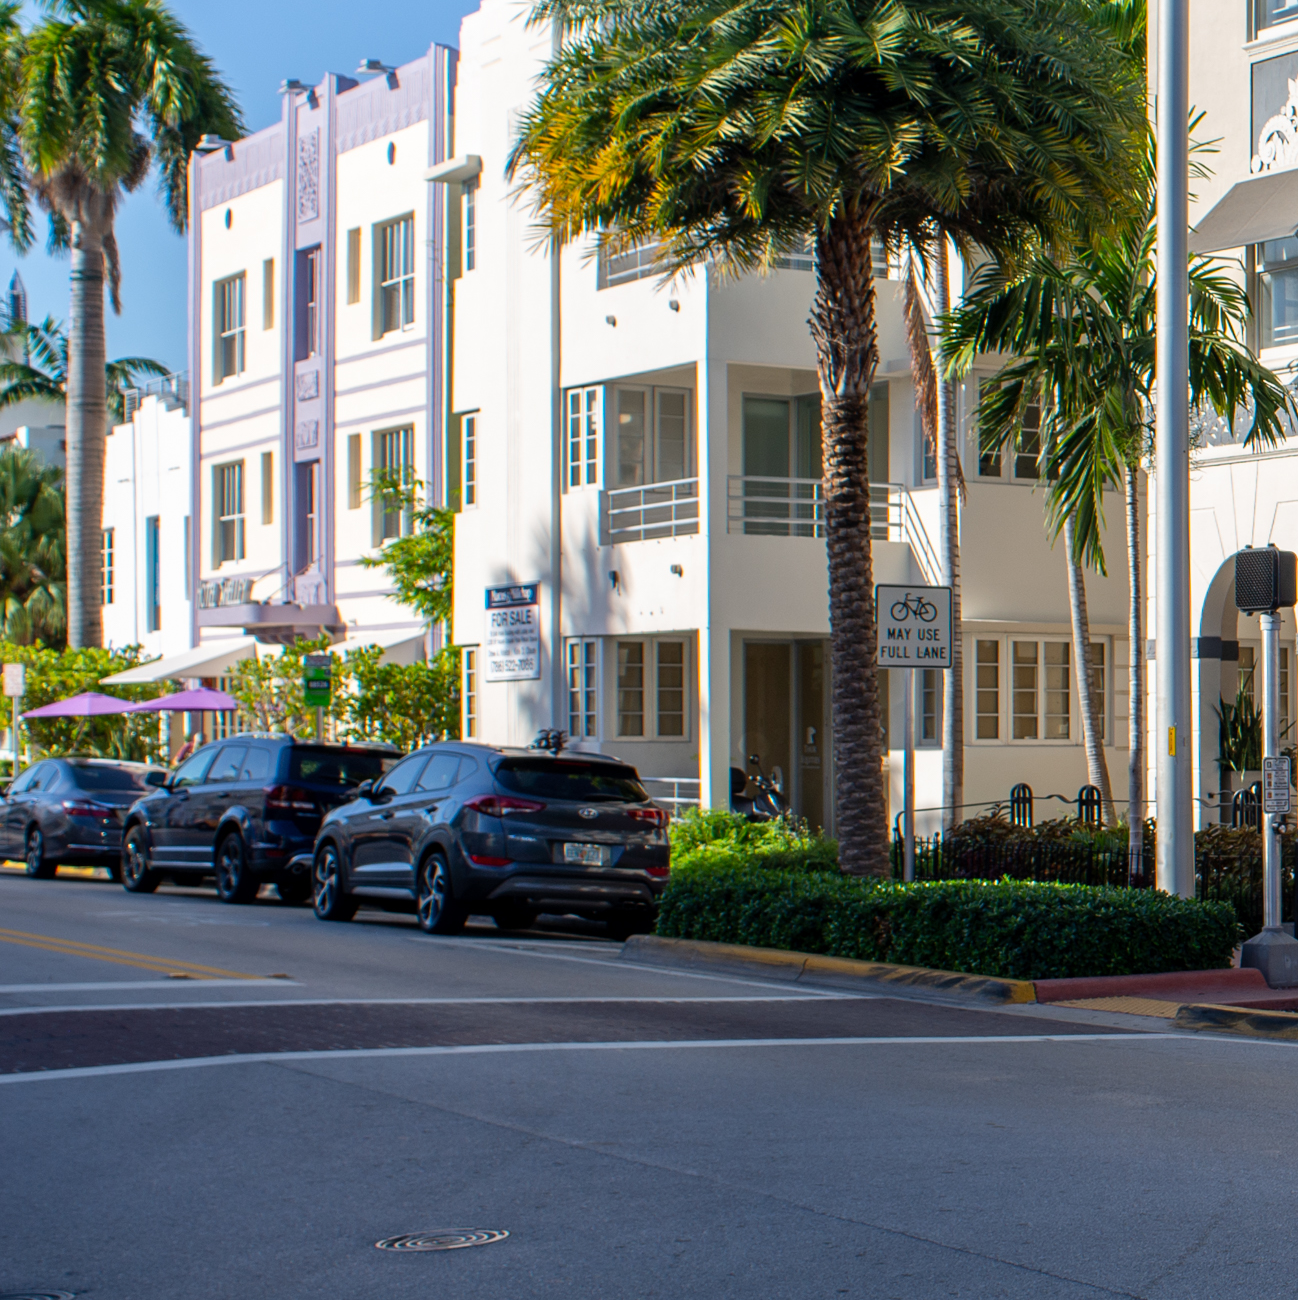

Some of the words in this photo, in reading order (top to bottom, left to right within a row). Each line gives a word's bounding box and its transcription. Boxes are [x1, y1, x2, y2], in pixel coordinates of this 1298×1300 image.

[491, 612, 508, 627] FOR
[509, 609, 532, 626] SALE
[887, 628, 911, 640] MAY
[918, 628, 940, 641] USE
[881, 646, 910, 658] FULL
[917, 647, 946, 659] LANE
